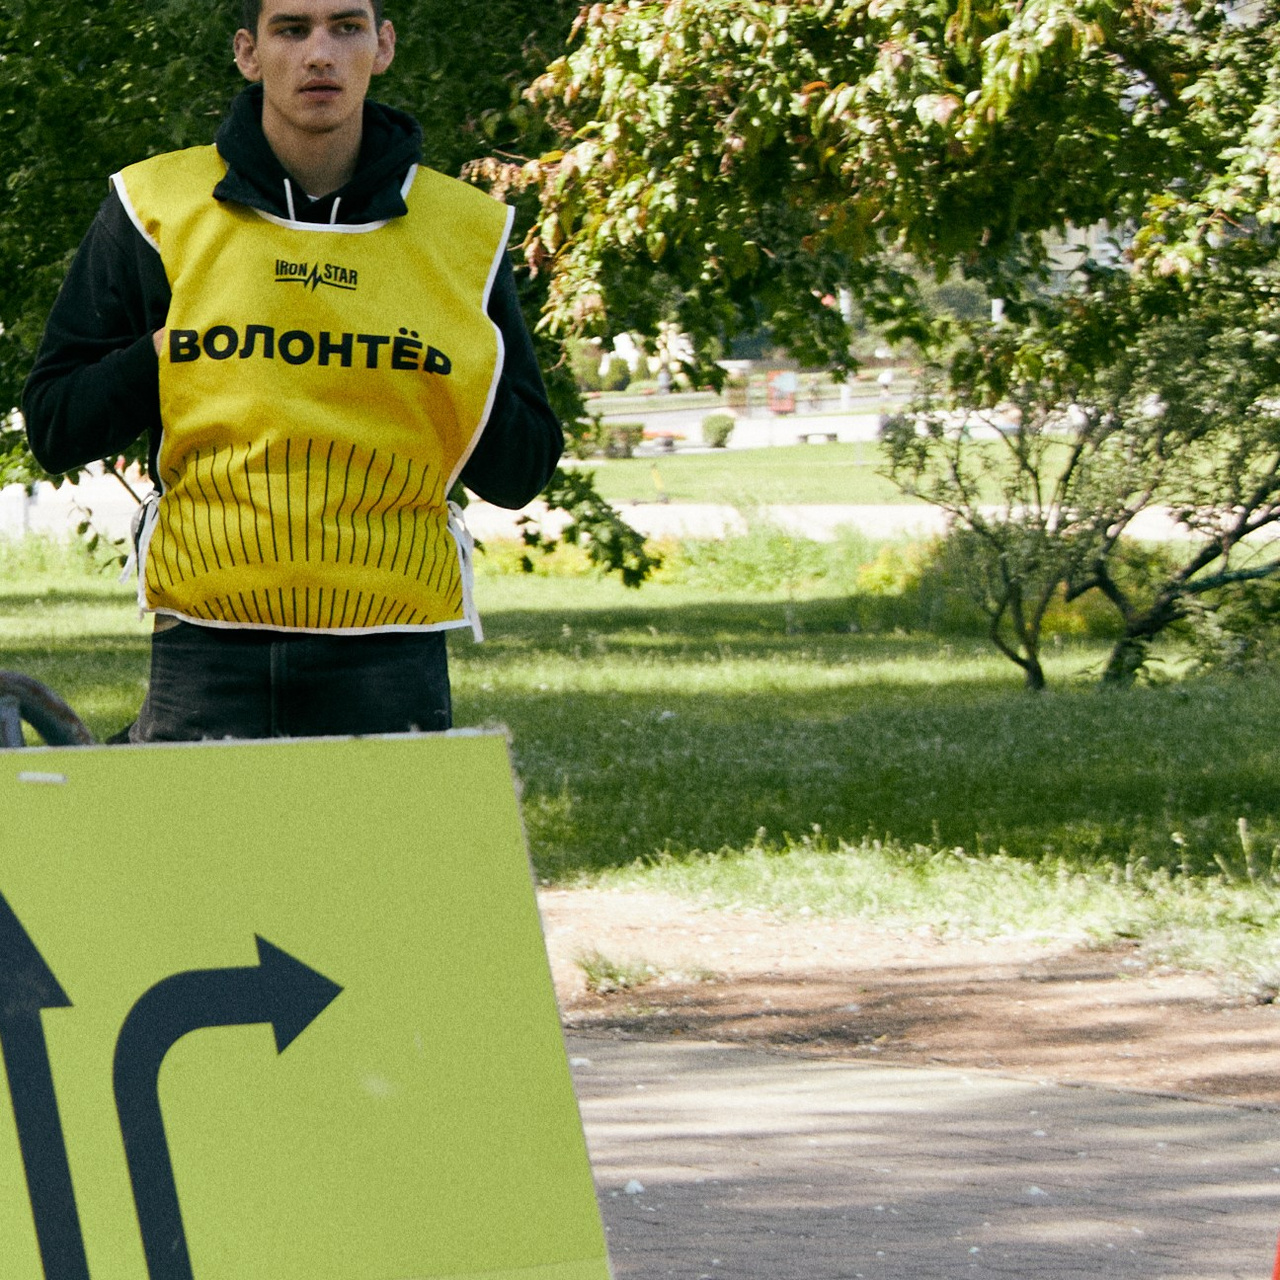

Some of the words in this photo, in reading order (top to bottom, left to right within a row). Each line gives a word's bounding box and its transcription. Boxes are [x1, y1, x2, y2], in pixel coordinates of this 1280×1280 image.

[275, 259, 308, 276] IRON
[323, 263, 358, 285] STAR
[169, 324, 452, 376] ВОЛОНТЁР
